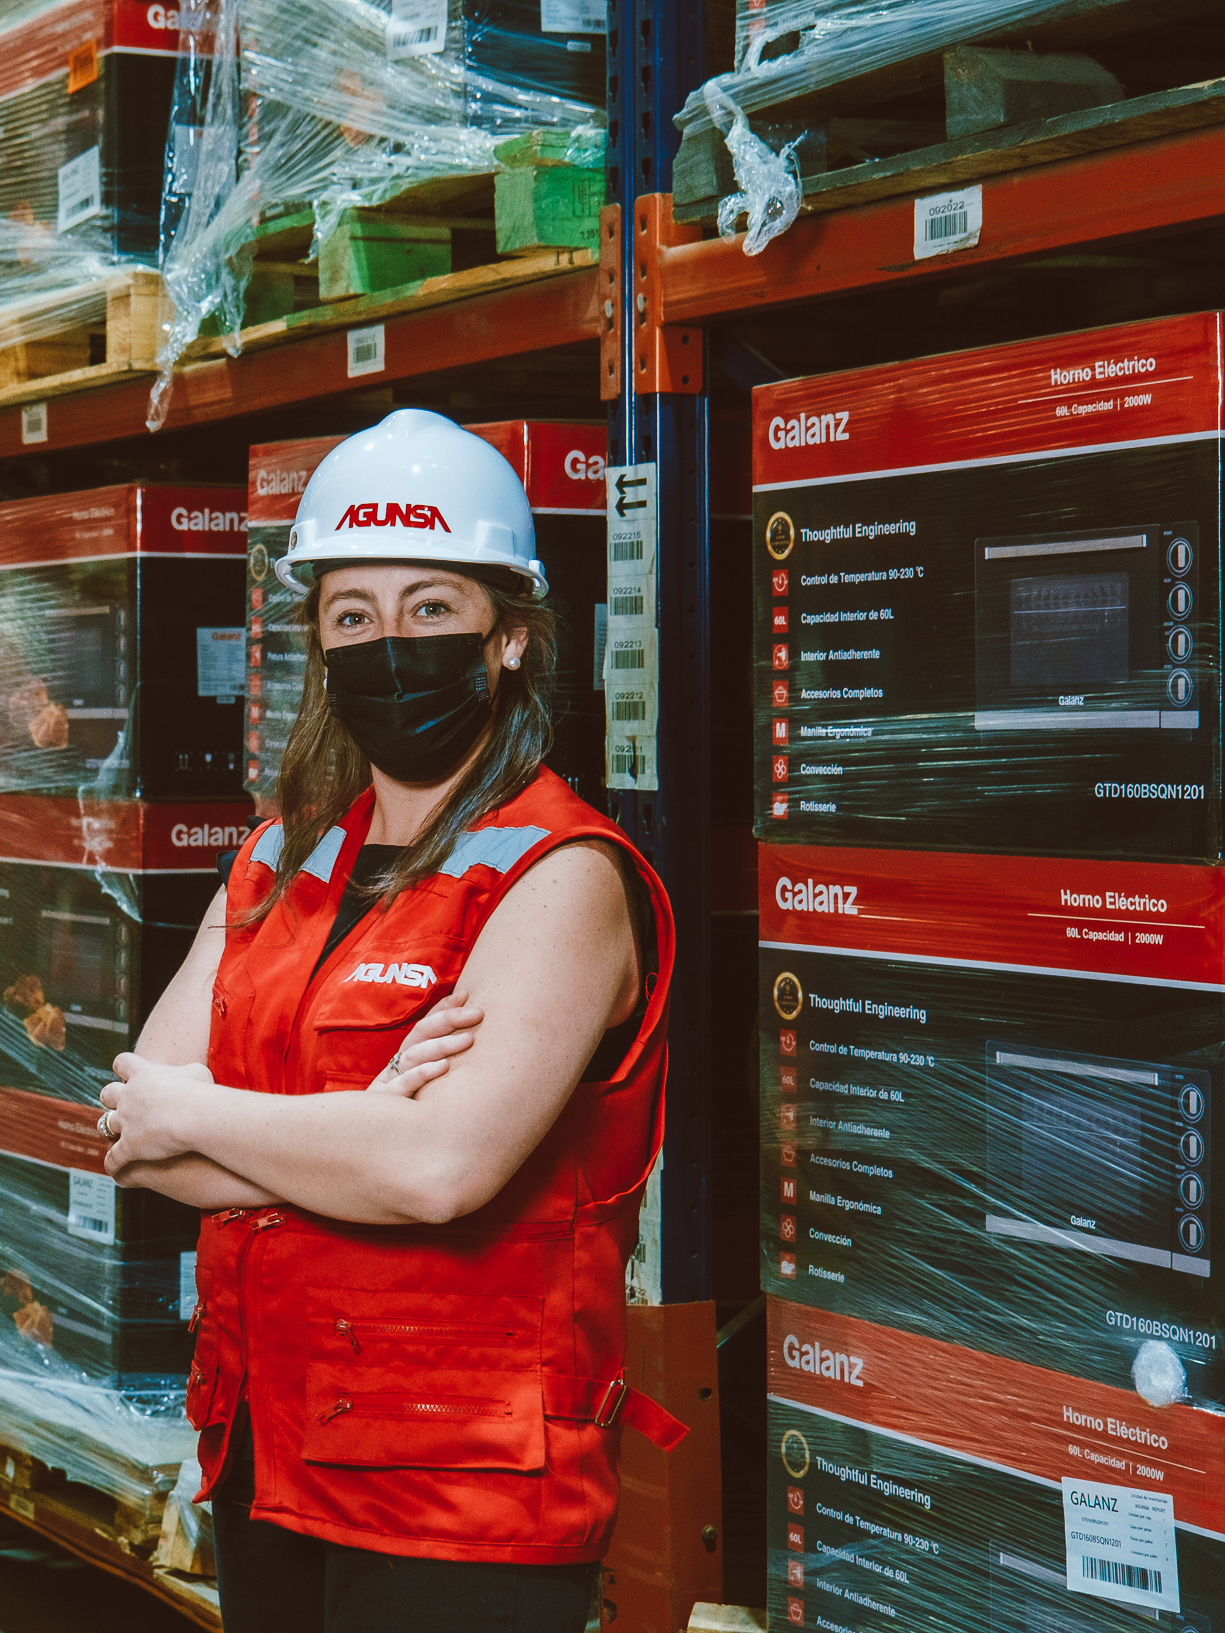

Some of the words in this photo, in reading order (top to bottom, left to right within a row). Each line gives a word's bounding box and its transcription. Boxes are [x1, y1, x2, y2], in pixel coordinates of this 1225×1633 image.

[929, 201, 965, 216] 092022
[1050, 367, 1092, 386] Horno
[1095, 356, 1156, 379] Eléctrico
[1056, 406, 1070, 416] 60L
[1072, 399, 1113, 416] Capacidad
[1124, 394, 1152, 408] 2000W
[768, 411, 850, 450] Galanz
[256, 469, 307, 496] Galanz
[334, 502, 452, 534] AGUNSA
[612, 531, 642, 540] 092215
[800, 524, 853, 543] Thoughtful
[856, 520, 916, 539] Engineering
[801, 574, 828, 586] Control
[829, 573, 838, 584] de
[840, 570, 887, 584] Temperatura
[888, 567, 914, 579] 90-230
[613, 587, 642, 595] 092214
[774, 616, 786, 625] 60L
[801, 612, 839, 625] Capacidad
[840, 610, 867, 622] Interior
[869, 609, 878, 620] de
[880, 608, 894, 620] 60L
[614, 640, 642, 648] 092213
[801, 650, 827, 662] Interior
[828, 649, 881, 661] Antiadherente
[615, 691, 644, 700] 092212
[801, 688, 842, 699] Accesorios
[842, 687, 883, 700] Completos
[1058, 695, 1084, 706] Galanz
[800, 726, 826, 737] Manilla
[828, 726, 873, 739] Ergonómica
[615, 745, 643, 753] 0921
[800, 763, 843, 775] Convección
[1094, 783, 1205, 800] GTD160BSQN1201
[800, 801, 837, 813] Rotisserie
[171, 824, 251, 847] Galanz
[776, 876, 858, 915] Galanz
[1060, 889, 1102, 908] Horno
[1105, 892, 1167, 913] Eléctrico
[1066, 927, 1081, 938] 60L
[1082, 928, 1124, 942] Capacidad
[1135, 933, 1163, 945] 2000W
[342, 962, 437, 989] AGUNSA
[809, 993, 862, 1013] Thoughtful
[865, 1000, 927, 1024] Engineering
[810, 1040, 837, 1054] Control
[838, 1045, 848, 1055] de
[849, 1046, 897, 1062] Temperatura
[899, 1053, 925, 1066] 90-230
[782, 1075, 794, 1086] 60L
[810, 1078, 849, 1093] Capacidad
[850, 1084, 878, 1098] Interior
[879, 1089, 889, 1099] de
[890, 1091, 905, 1102] 60L
[810, 1116, 836, 1129] Interior
[838, 1120, 890, 1139] Antiadherente
[810, 1154, 851, 1170] Accesorios
[852, 1161, 894, 1178] Completos
[810, 1190, 835, 1205] Manilla
[837, 1195, 882, 1215] Ergonómica
[1070, 1214, 1096, 1230] Galanz
[809, 1228, 852, 1247] Convección
[809, 1265, 845, 1283] Rotisserie
[1106, 1310, 1216, 1349] GTD160BSQN1201
[783, 1334, 864, 1387] Galanz
[1063, 1405, 1104, 1432] Horno
[1107, 1418, 1168, 1450] Eléctrico
[1068, 1444, 1082, 1458] 60L
[1084, 1449, 1126, 1470] Capacidad
[1136, 1464, 1164, 1482] 2000W
[816, 1456, 868, 1486] Thoughtful
[870, 1475, 931, 1509] Engineering
[1070, 1490, 1119, 1512] GALANZ
[789, 1532, 802, 1544] 60L
[816, 1503, 843, 1521] Control
[845, 1513, 854, 1524] de
[855, 1515, 903, 1542] Temperatura
[904, 1533, 930, 1551] 90-230
[1071, 1531, 1121, 1548] GTD160BSQN1201
[816, 1540, 854, 1563] Capacidad
[856, 1554, 882, 1574] Interior
[884, 1566, 894, 1578] de
[895, 1570, 910, 1584] 60L
[816, 1578, 843, 1596] Interior
[844, 1588, 896, 1618] Antiadherente
